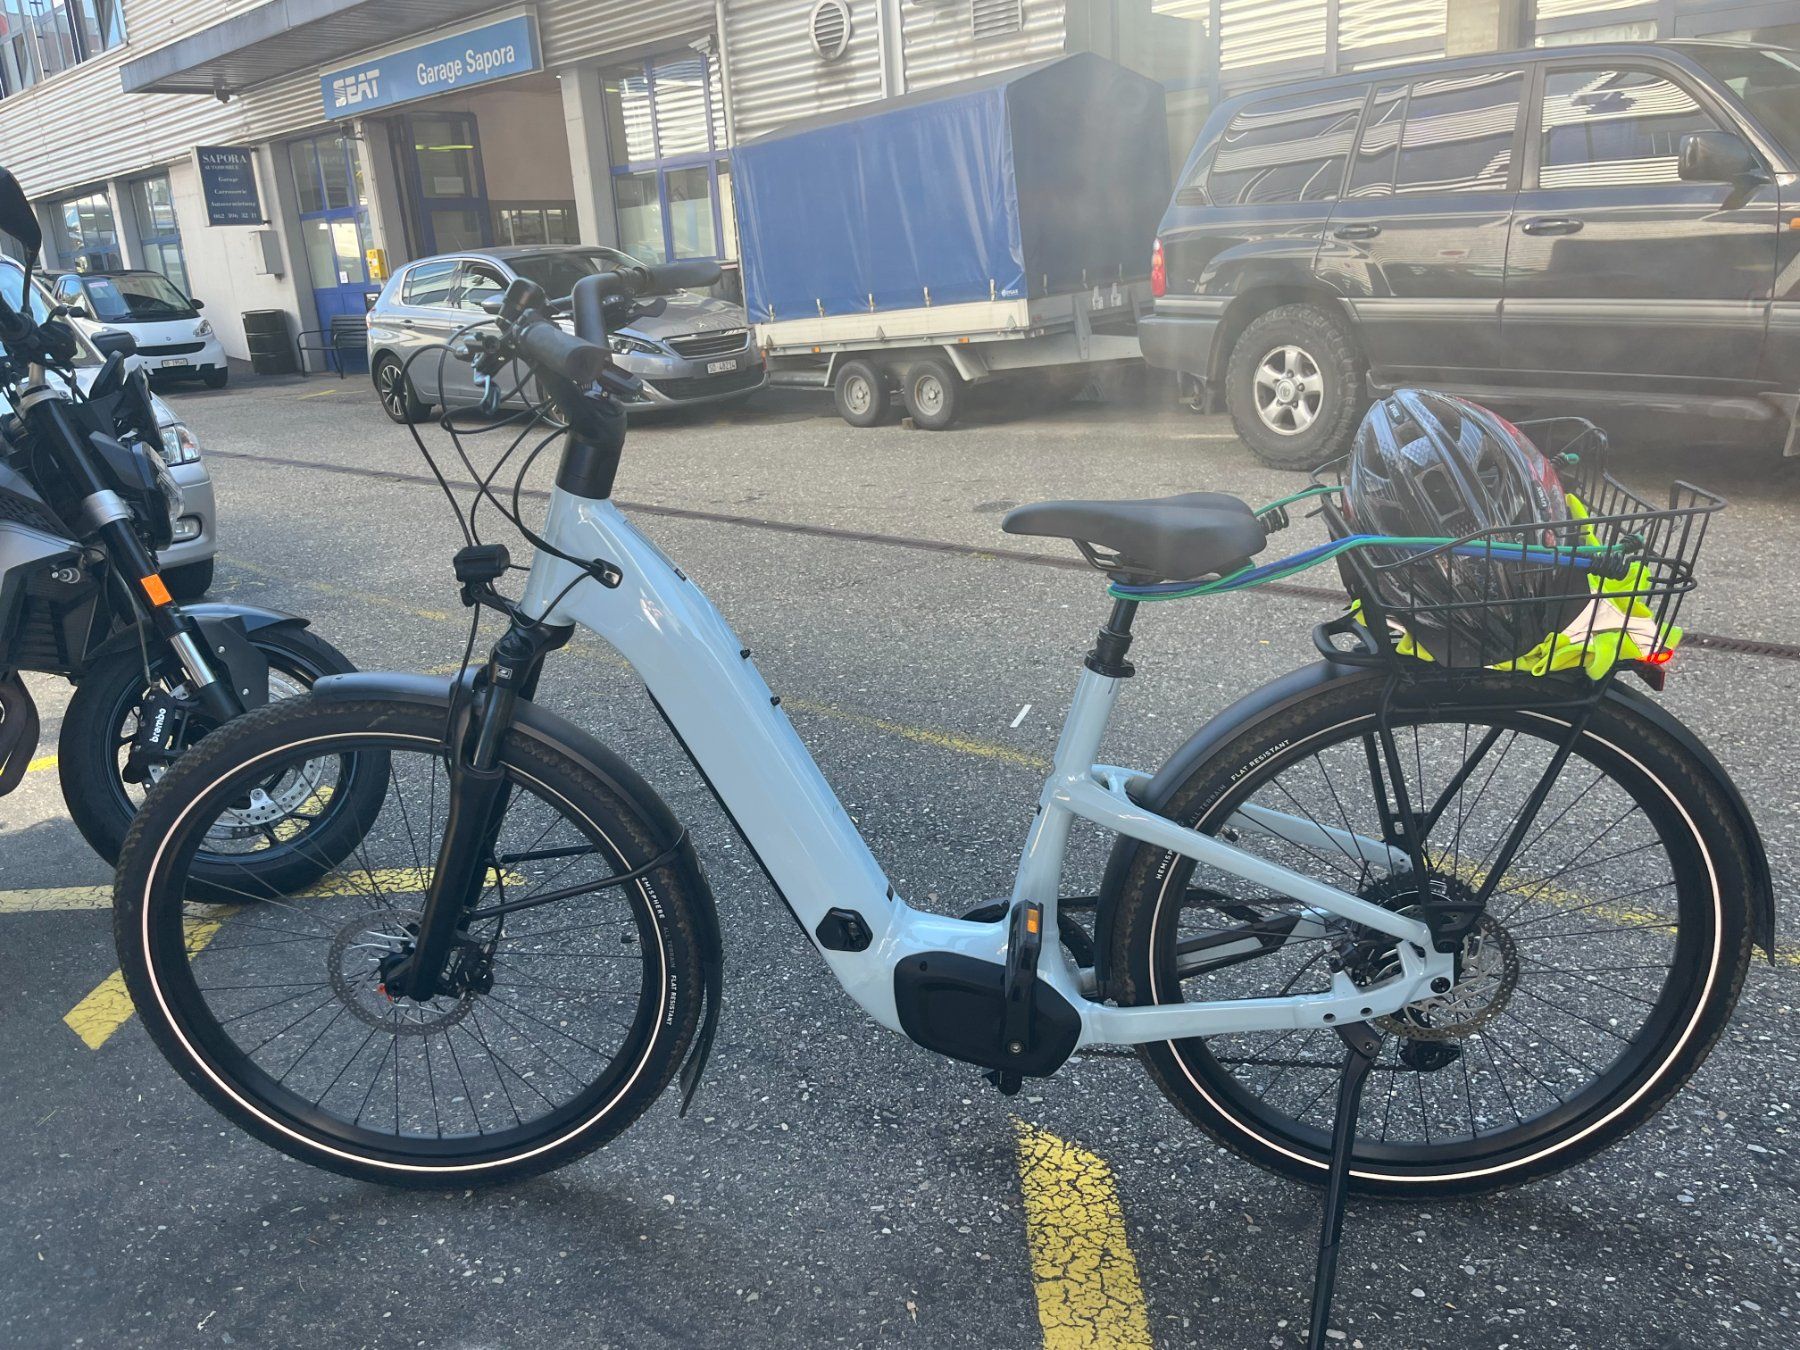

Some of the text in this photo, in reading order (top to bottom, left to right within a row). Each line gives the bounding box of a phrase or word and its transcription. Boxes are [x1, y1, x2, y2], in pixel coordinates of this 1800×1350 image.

[416, 45, 515, 85] Garage Sapora
[333, 69, 380, 108] SEAT
[202, 153, 247, 164] SAPORA
[149, 708, 167, 743] brembo
[1230, 739, 1290, 782] FLAT RESISTANT
[641, 876, 666, 919] EMISPHERE
[665, 991, 677, 1026] RESISTANT
